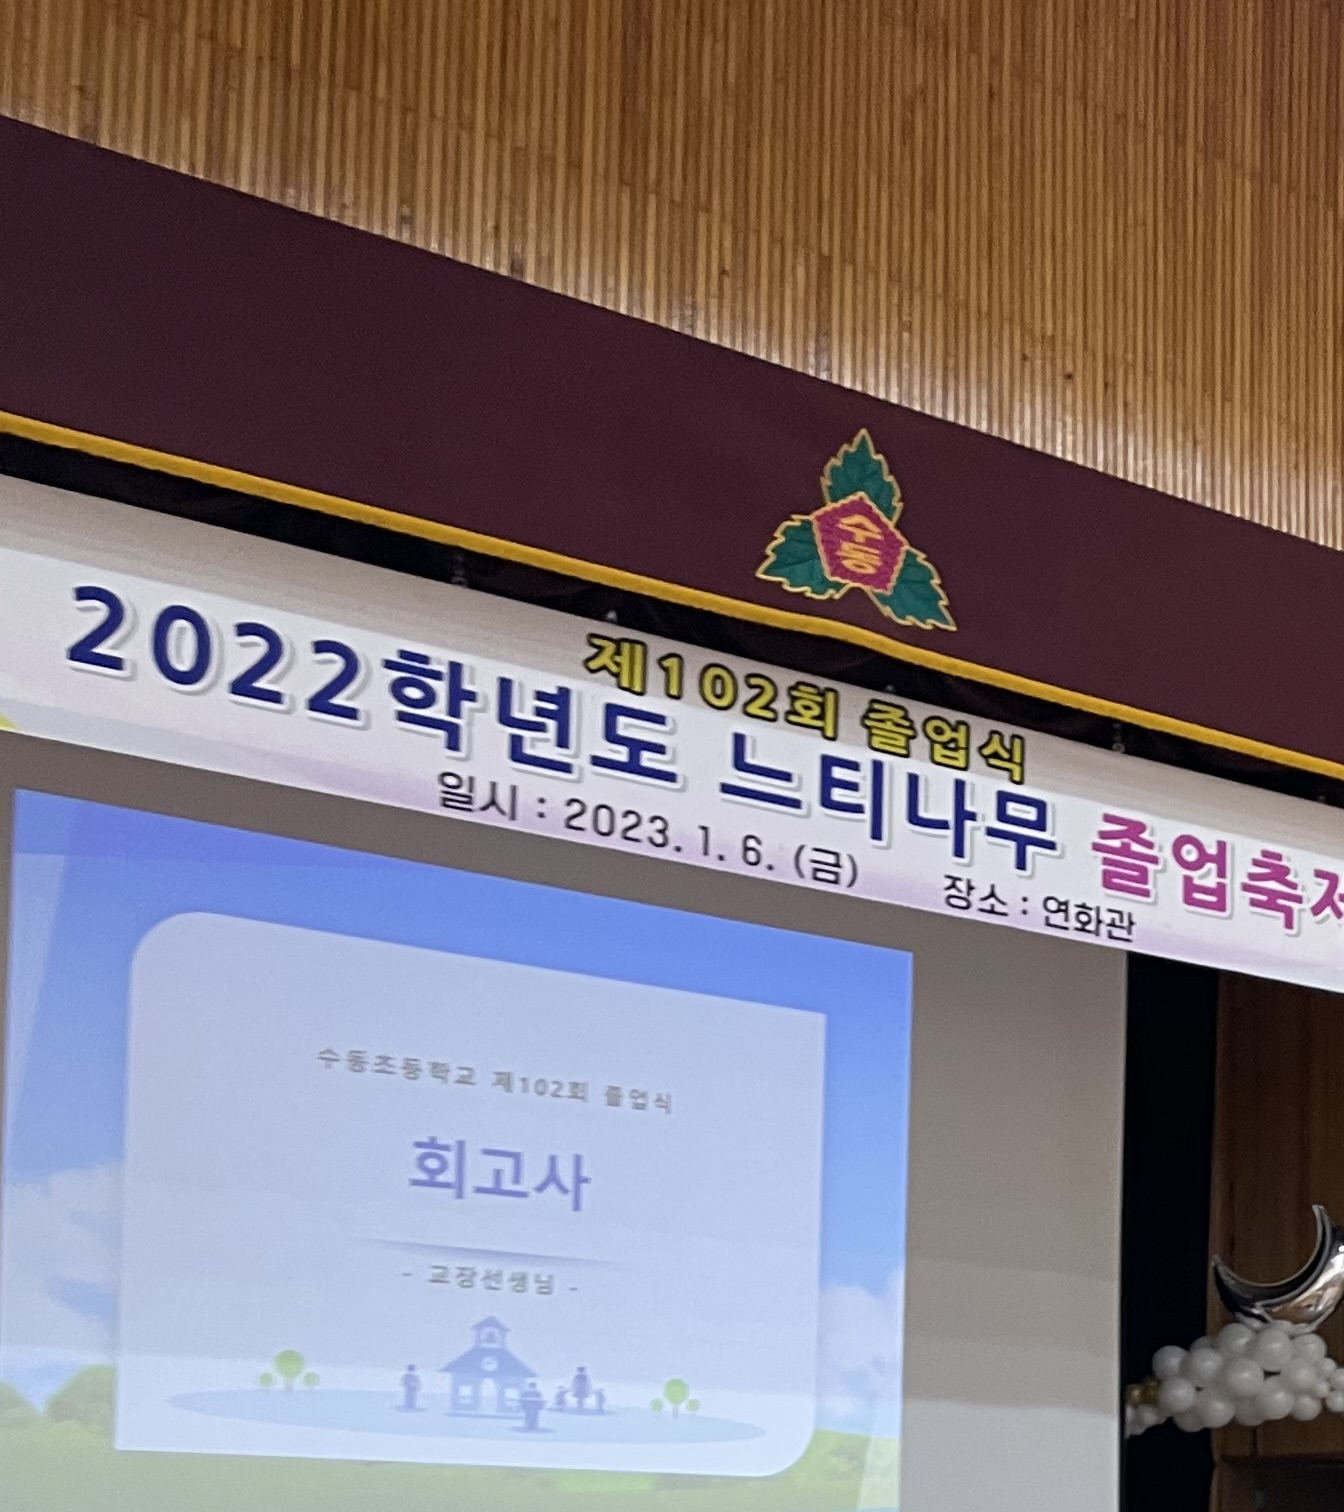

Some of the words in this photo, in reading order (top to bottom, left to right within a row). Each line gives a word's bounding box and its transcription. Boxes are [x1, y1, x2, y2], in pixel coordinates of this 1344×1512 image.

[836, 514, 884, 574] 수동
[66, 585, 679, 784] 2022학년도
[719, 732, 1057, 872] 느티나무
[583, 632, 839, 740] 제102회
[862, 697, 1025, 784] 졸업식
[437, 771, 518, 821] 일시
[793, 843, 859, 888] (금)
[943, 874, 1009, 919] 장소
[1042, 894, 1136, 943] 연화관
[491, 1070, 589, 1103] 제102회
[408, 1136, 592, 1212] 회고사
[427, 1264, 554, 1296] 교장선생님
